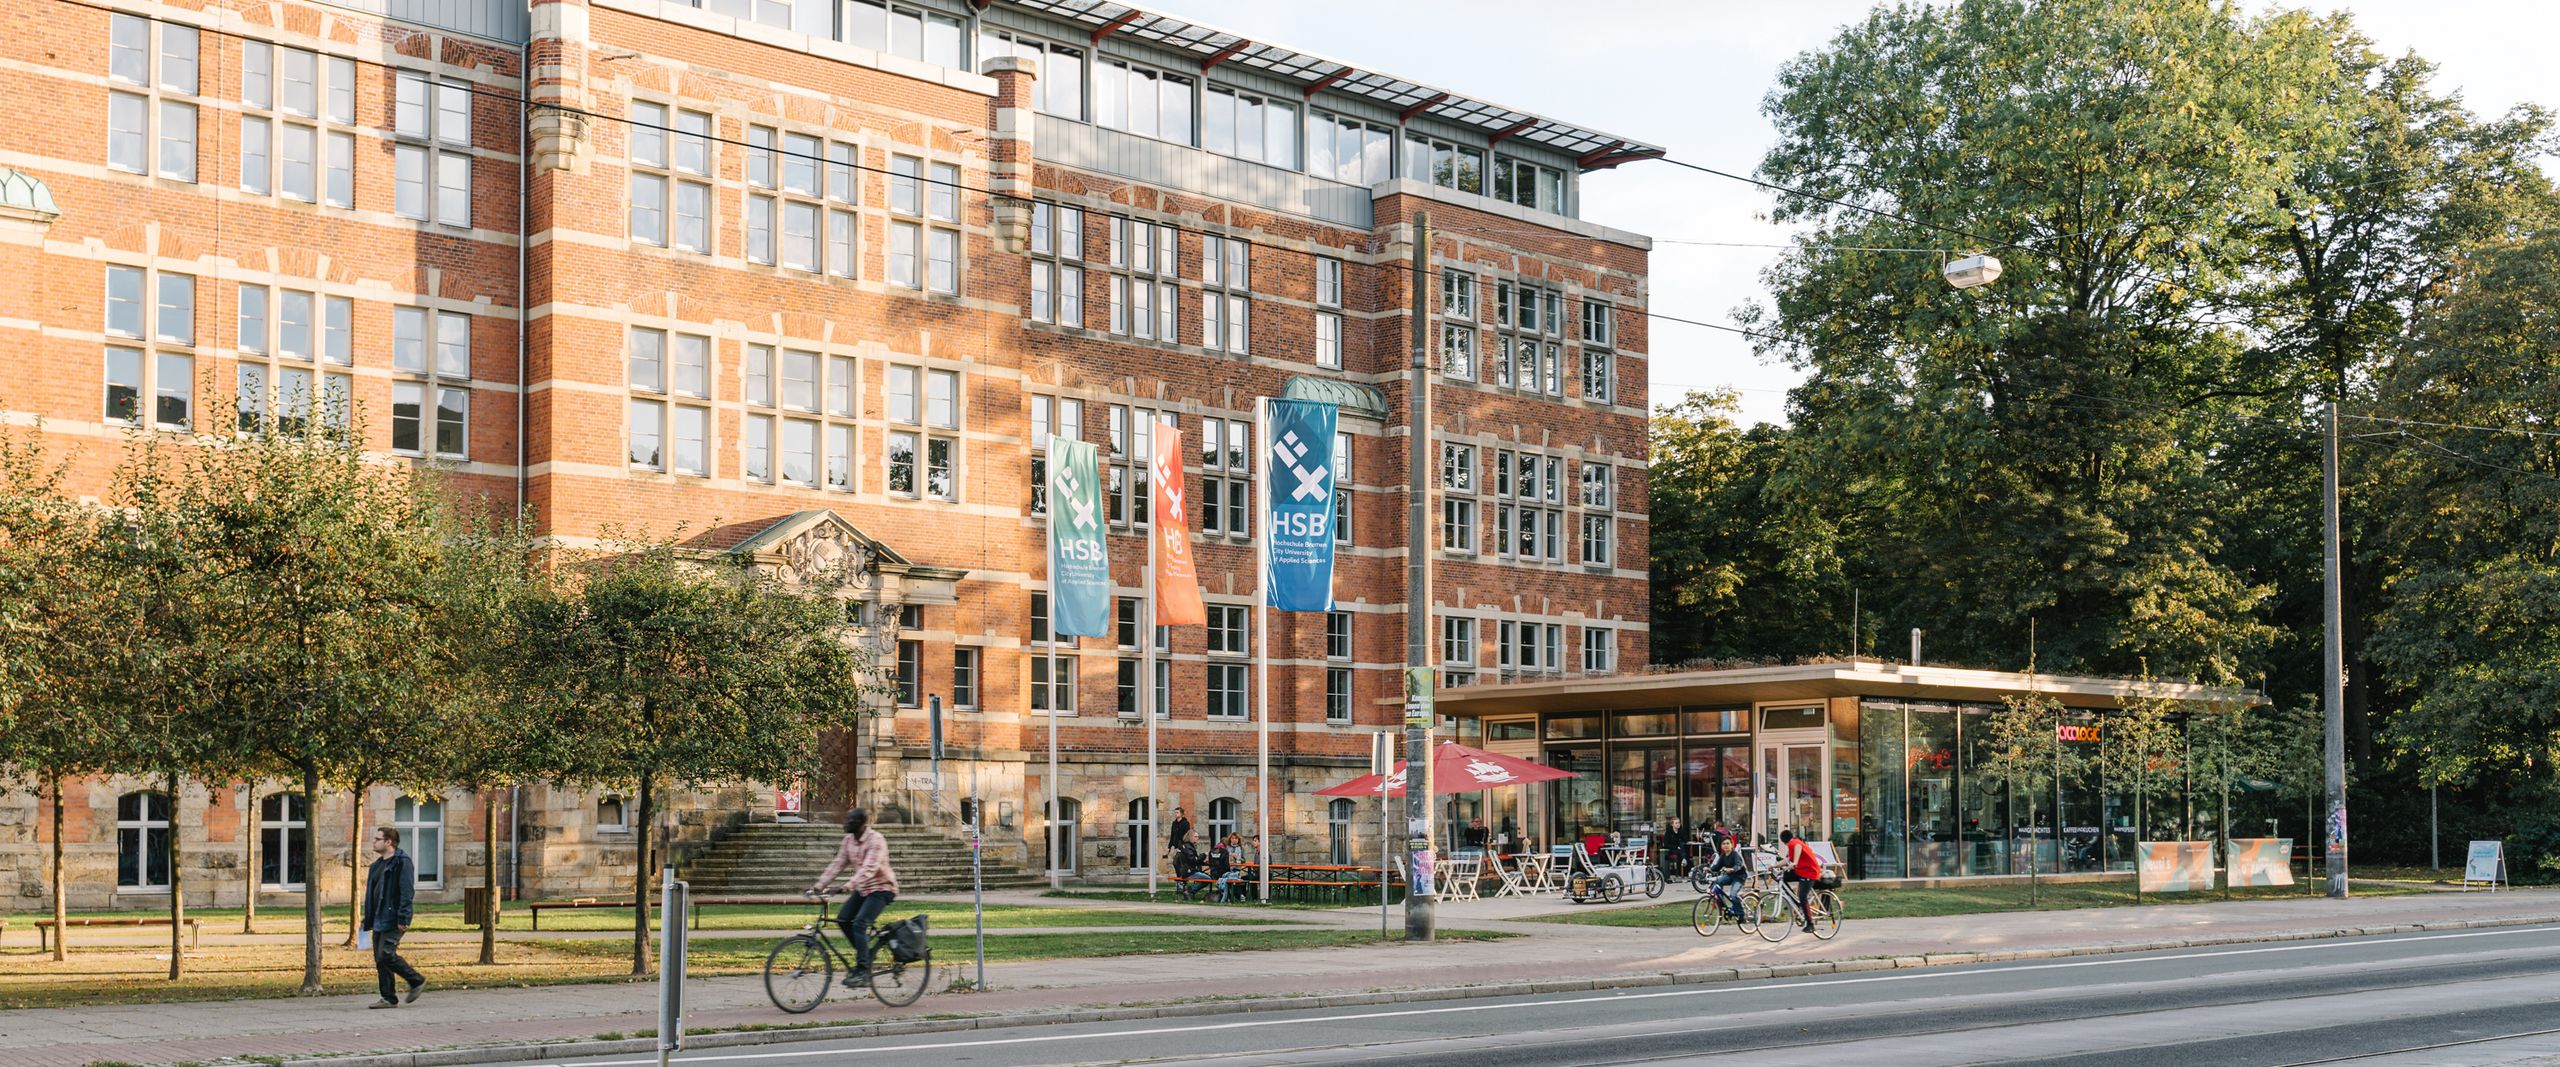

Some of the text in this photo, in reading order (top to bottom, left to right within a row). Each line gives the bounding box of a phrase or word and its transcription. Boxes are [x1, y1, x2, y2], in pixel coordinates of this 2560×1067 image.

[1272, 511, 1325, 537] HSB
[1060, 538, 1103, 561] HSB
[1285, 548, 1313, 556] University
